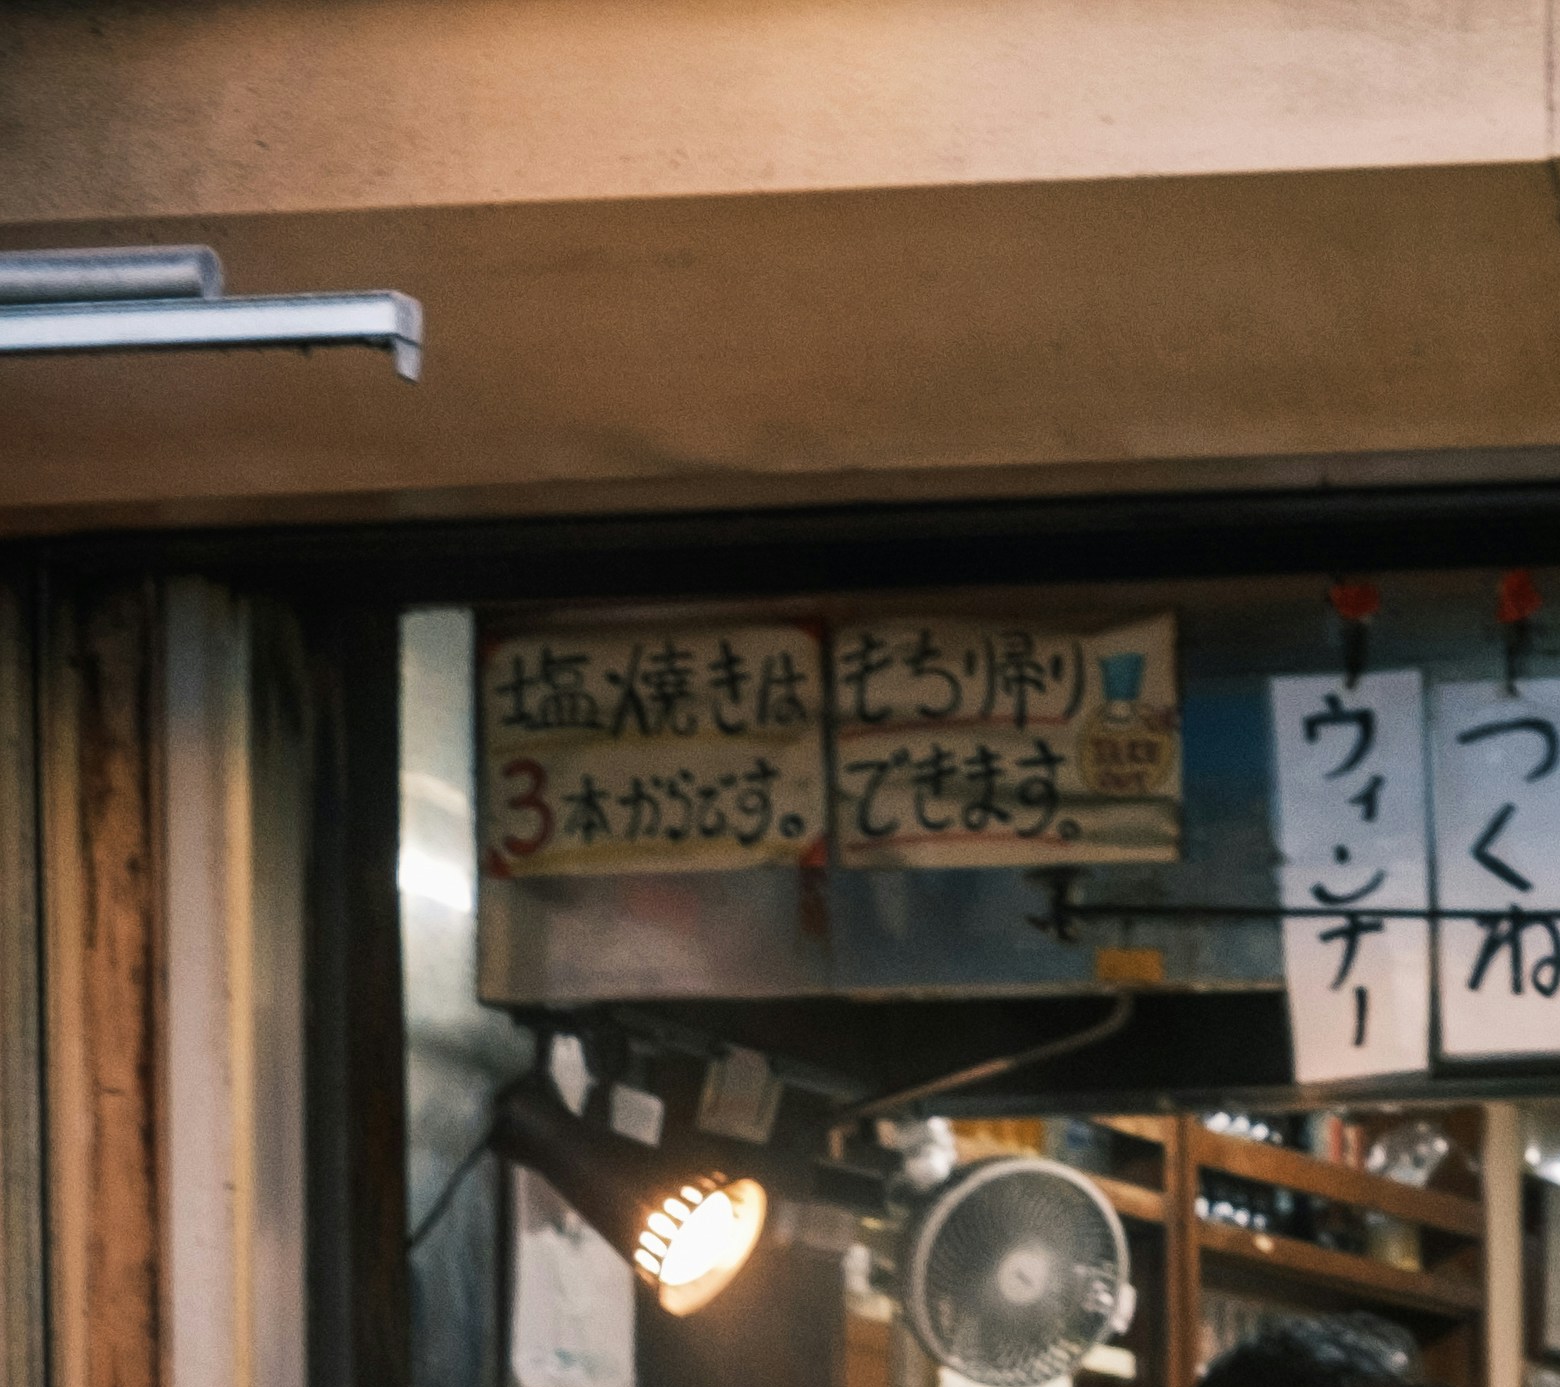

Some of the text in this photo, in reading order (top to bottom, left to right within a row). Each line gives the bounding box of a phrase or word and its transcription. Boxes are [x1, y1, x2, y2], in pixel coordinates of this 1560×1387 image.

[495, 640, 811, 742] 塩焼きは
[838, 628, 1088, 732] もち帰り
[500, 757, 807, 857] 3本からです。
[845, 740, 1085, 845] できます。
